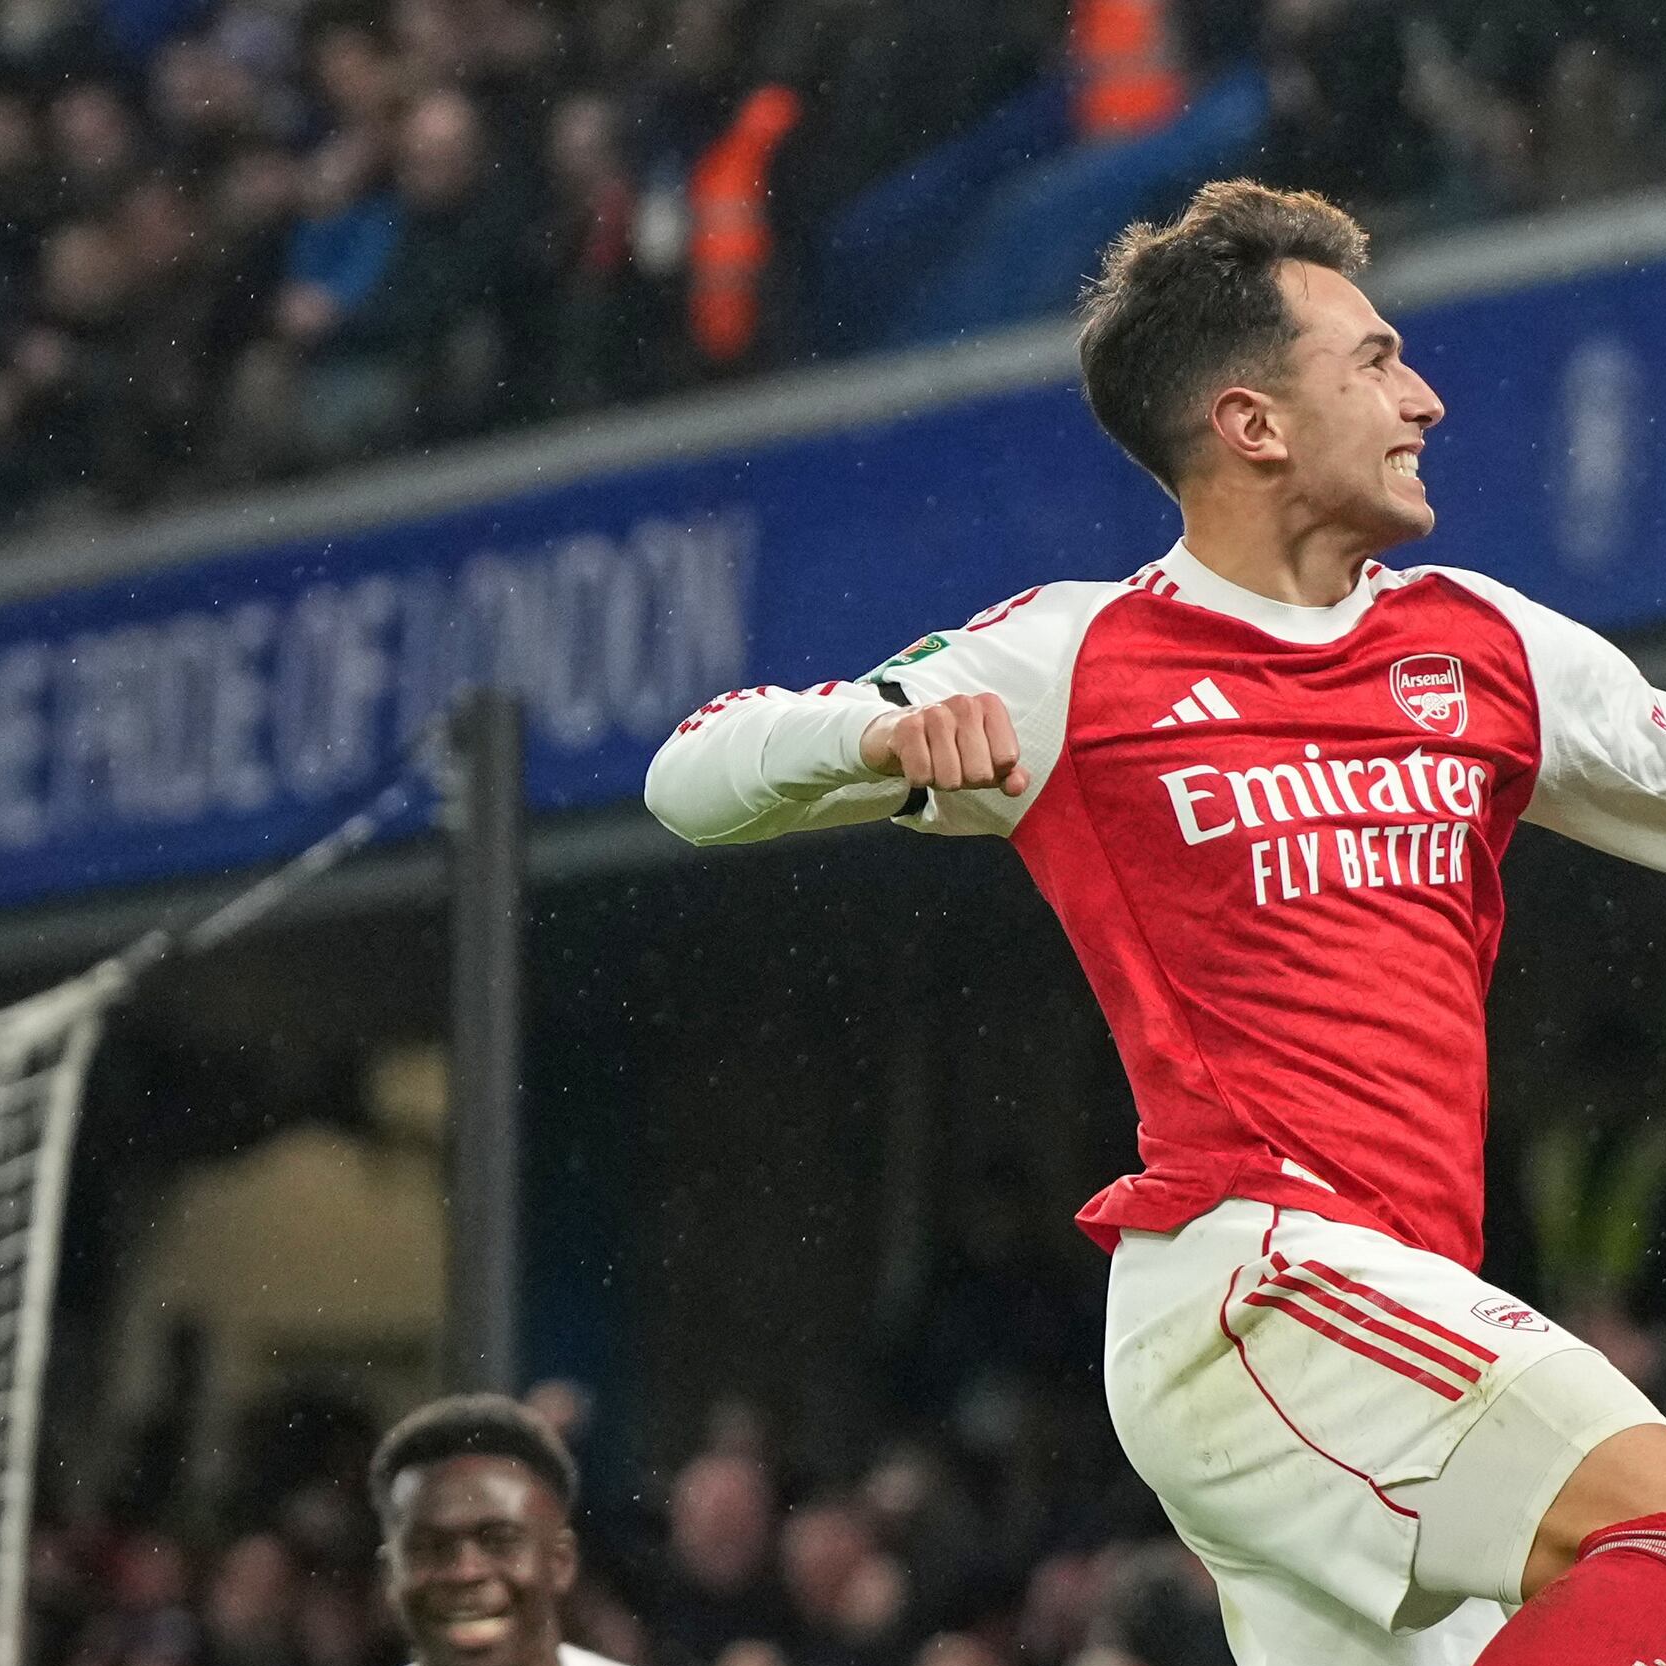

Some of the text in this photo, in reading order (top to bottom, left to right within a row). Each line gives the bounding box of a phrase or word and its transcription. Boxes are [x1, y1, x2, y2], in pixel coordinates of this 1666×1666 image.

[52, 600, 274, 835] PRIDE
[276, 575, 396, 802] OF
[1400, 669, 1453, 688] Arsenal
[1158, 743, 1486, 846] Emirates
[1251, 821, 1471, 906] FLY BETTER
